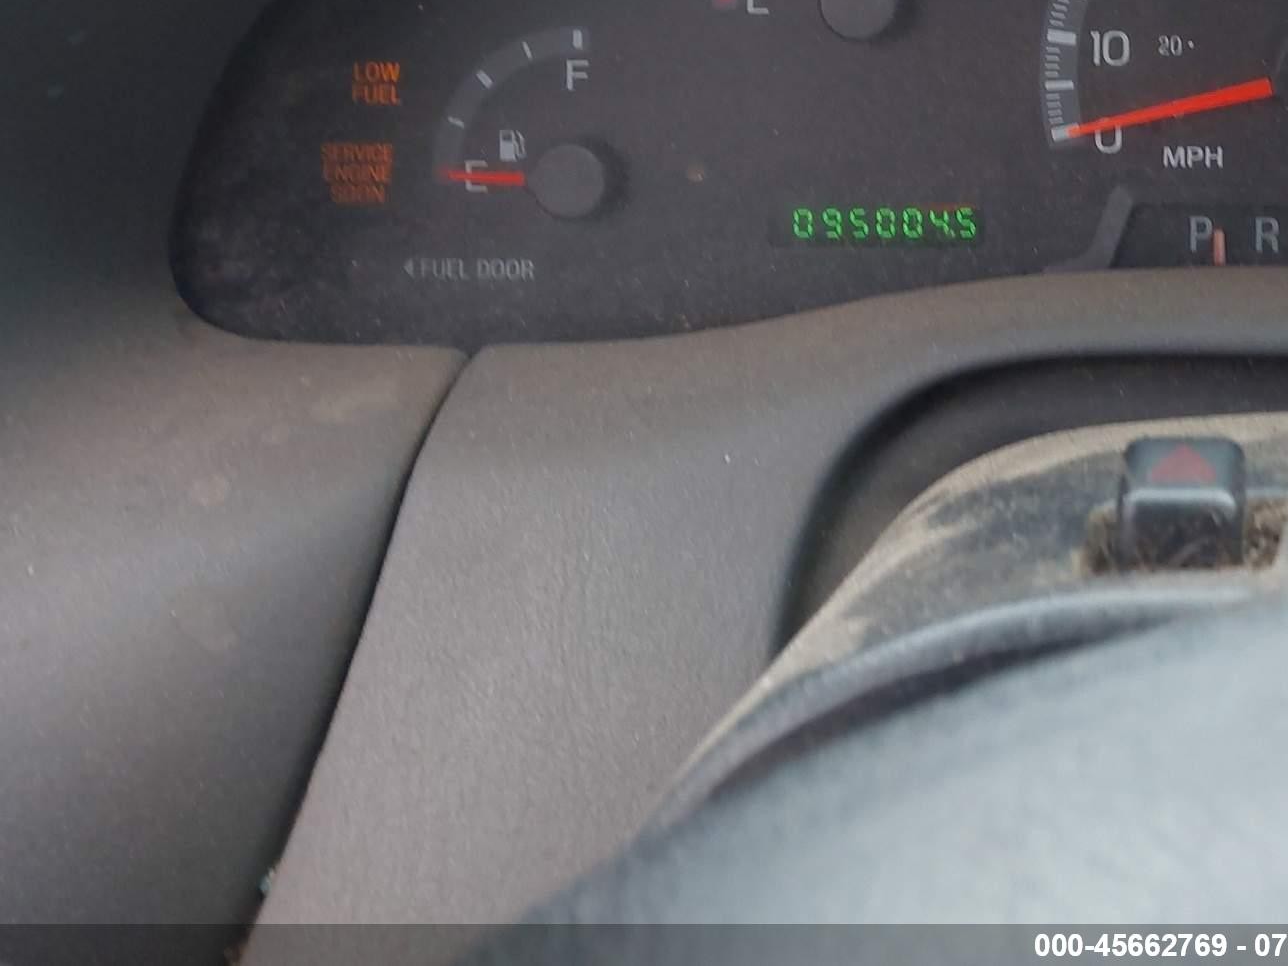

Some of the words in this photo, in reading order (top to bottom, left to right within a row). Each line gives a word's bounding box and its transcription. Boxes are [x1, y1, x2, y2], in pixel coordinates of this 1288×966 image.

[1091, 30, 1130, 66] 10
[1159, 36, 1182, 56] 20
[353, 61, 400, 83] LOW
[566, 59, 590, 91] F
[352, 85, 400, 106] FUEL
[1094, 118, 1122, 154] 0
[321, 143, 393, 163] SERVICE
[1163, 145, 1224, 169] MPH
[322, 164, 392, 183] ENGINE
[465, 160, 488, 193] E
[330, 184, 386, 205] SOON
[1189, 216, 1213, 252] P
[1255, 217, 1279, 254] R
[419, 258, 468, 280] FUEL
[476, 259, 535, 281] DOOR
